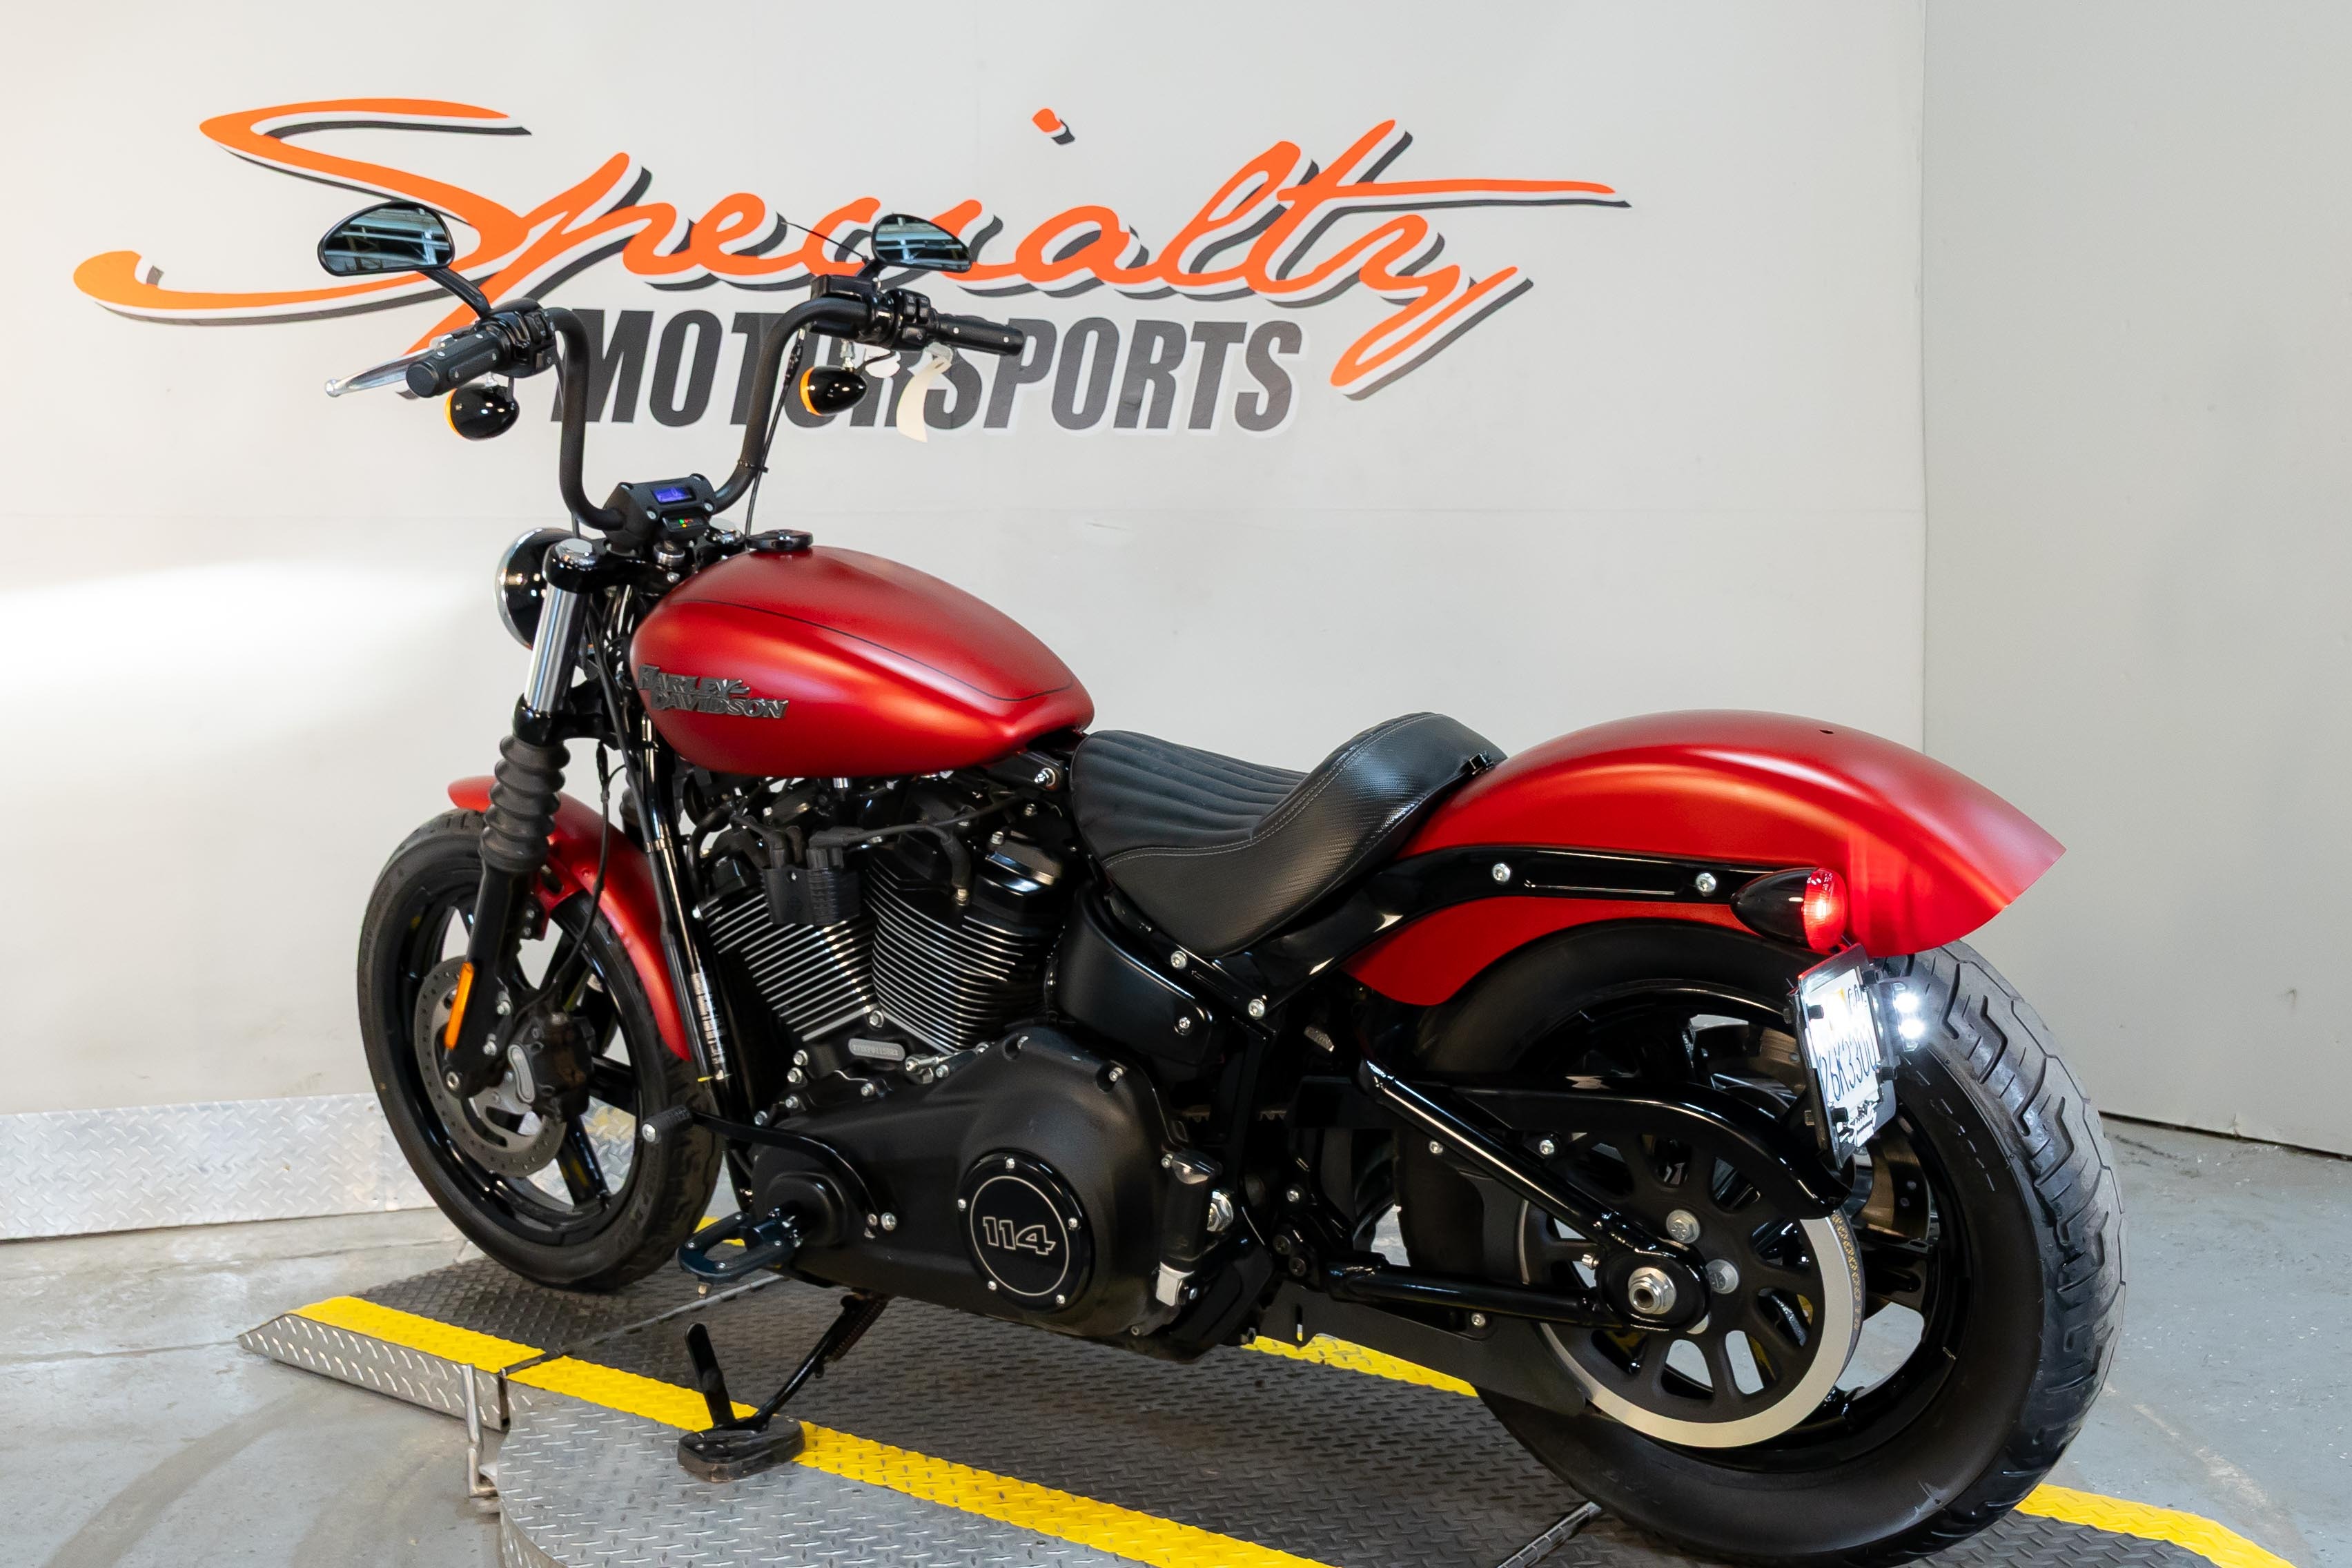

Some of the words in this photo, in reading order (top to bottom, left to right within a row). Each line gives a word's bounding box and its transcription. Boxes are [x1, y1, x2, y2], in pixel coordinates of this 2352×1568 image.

[72, 97, 1630, 400] Specialty
[651, 692, 789, 719] DAVIDSON
[982, 1216, 1057, 1256] 114
